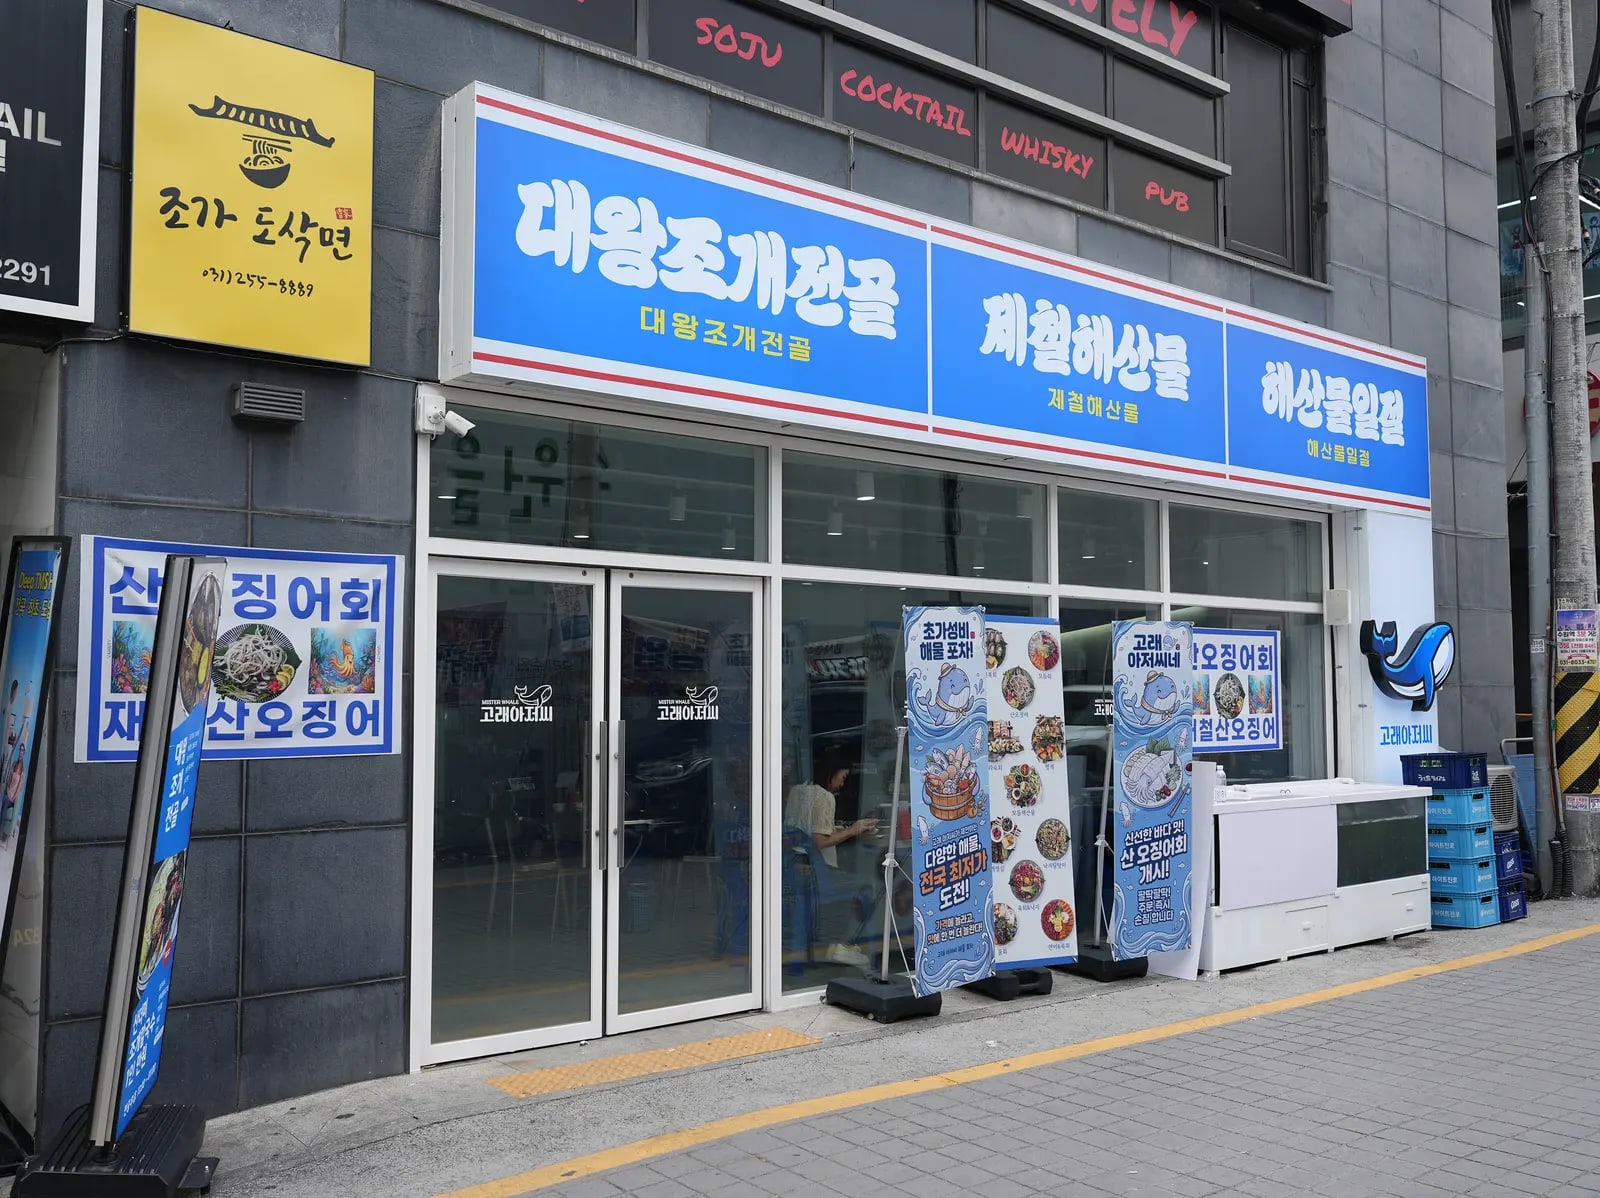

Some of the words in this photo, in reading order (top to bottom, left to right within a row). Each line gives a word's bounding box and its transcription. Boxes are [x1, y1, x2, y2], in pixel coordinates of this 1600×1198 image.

[694, 15, 783, 69] SOJU
[1068, 0, 1197, 56] ELY
[840, 69, 971, 137] COCKTAIL
[1000, 126, 1095, 180] WHISKY
[1144, 180, 1191, 213] PUB
[159, 187, 238, 229] 조가
[252, 206, 353, 263] 도삭면
[515, 178, 900, 340] 대왕조개전골
[639, 305, 812, 362] 대왕조개전골
[978, 292, 1191, 401] 제철해산물
[1047, 386, 1140, 424] 제철해산물
[1260, 360, 1406, 447] 해산물일절
[1306, 438, 1371, 467] 해산물일절
[110, 566, 381, 622] 산징어회
[923, 621, 970, 641] 초가성비
[1133, 634, 1162, 651] 고래
[920, 642, 944, 661] 해물
[947, 641, 974, 660] 포차!
[1127, 652, 1181, 669] 아저씨네
[103, 700, 381, 741] 재산오징어
[480, 706, 553, 723] 고래아저씨
[656, 705, 719, 721] 고래아저씨
[1379, 724, 1433, 746] 고래아저씨
[1120, 849, 1134, 869] 산
[1137, 834, 1188, 865] 오징어회
[1124, 827, 1154, 847] 신선한
[1153, 823, 1171, 840] 바다
[920, 868, 949, 893] 전국
[950, 852, 988, 883] 최저가
[925, 843, 957, 869] 다양한
[1139, 860, 1170, 884] 개시!
[939, 883, 970, 911] 도전!
